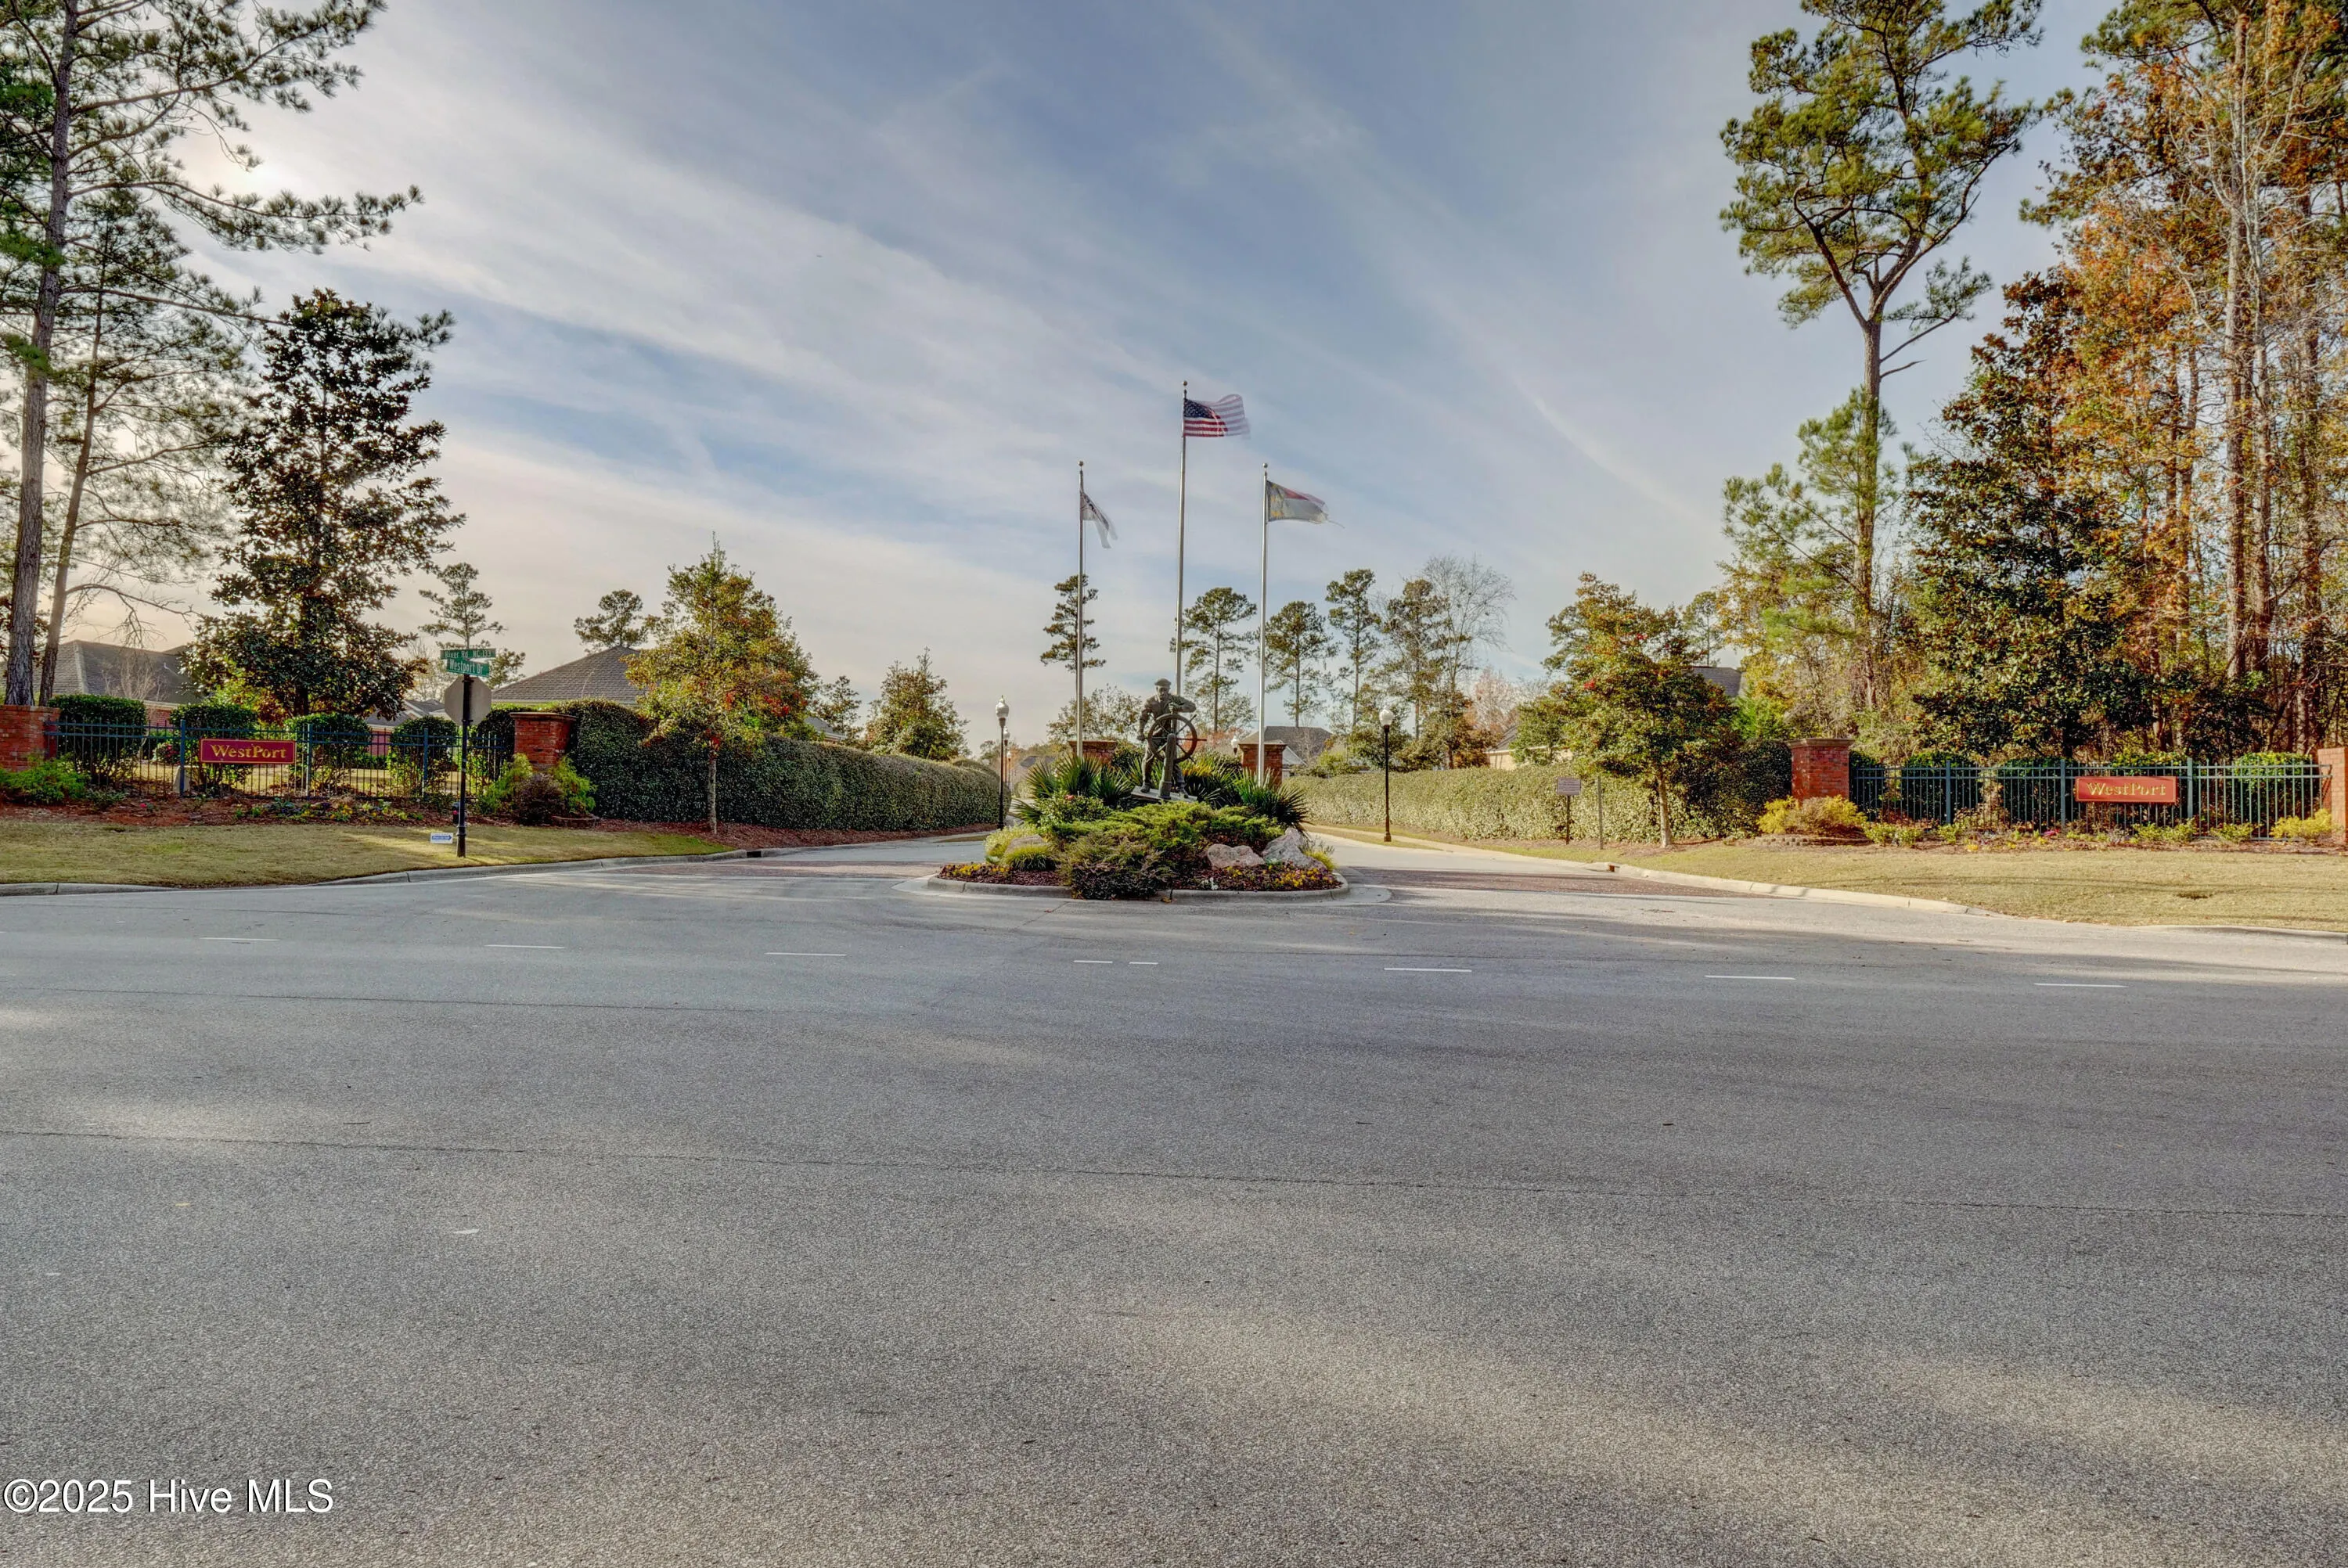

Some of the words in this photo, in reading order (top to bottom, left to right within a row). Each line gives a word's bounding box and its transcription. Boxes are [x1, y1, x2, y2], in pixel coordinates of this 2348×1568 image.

[449, 659, 476, 674] Westport
[477, 663, 484, 674] Dr
[210, 744, 286, 758] WestPort
[2086, 782, 2166, 796] WestPort
